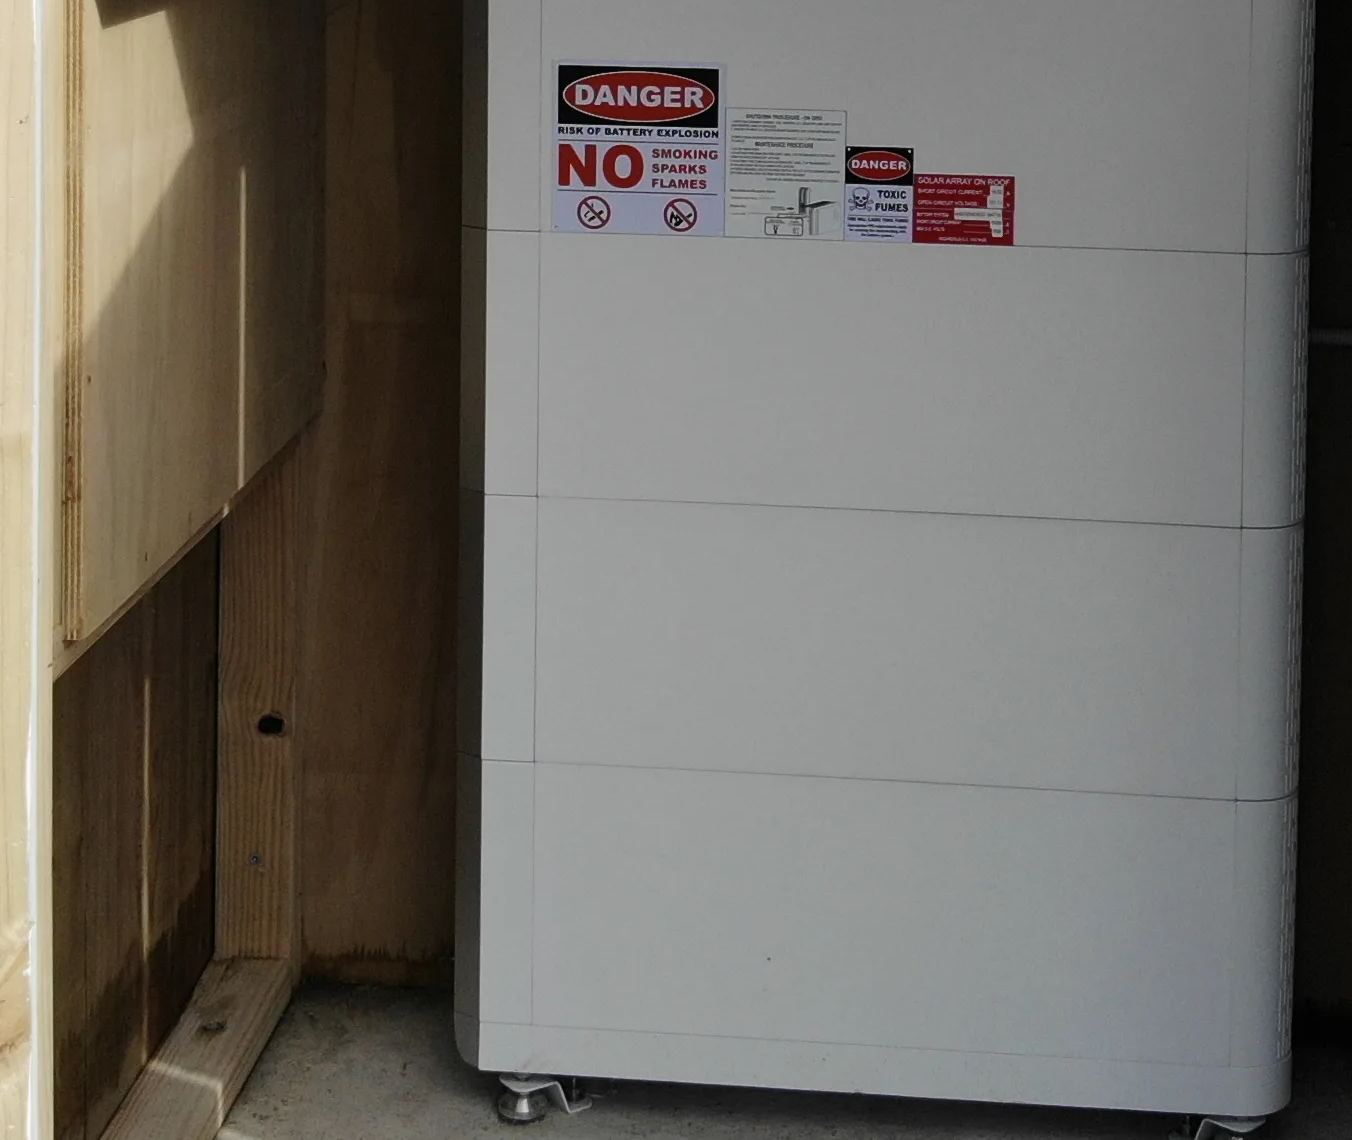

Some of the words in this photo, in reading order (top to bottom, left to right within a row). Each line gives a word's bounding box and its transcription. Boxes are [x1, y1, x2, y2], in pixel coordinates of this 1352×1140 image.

[576, 84, 704, 108] DANGER
[558, 126, 583, 135] RISK
[587, 127, 601, 135] OF
[605, 128, 653, 137] BATTERY
[658, 129, 718, 138] EXPLOSION
[652, 149, 718, 160] SMOKING
[559, 144, 644, 188] NO
[652, 164, 707, 175] SPARKS
[851, 159, 907, 170] DANGER
[652, 179, 707, 189] FLAMES
[945, 177, 971, 185] ARRAY
[877, 190, 907, 199] TOXIC
[875, 202, 908, 212] FUMES
